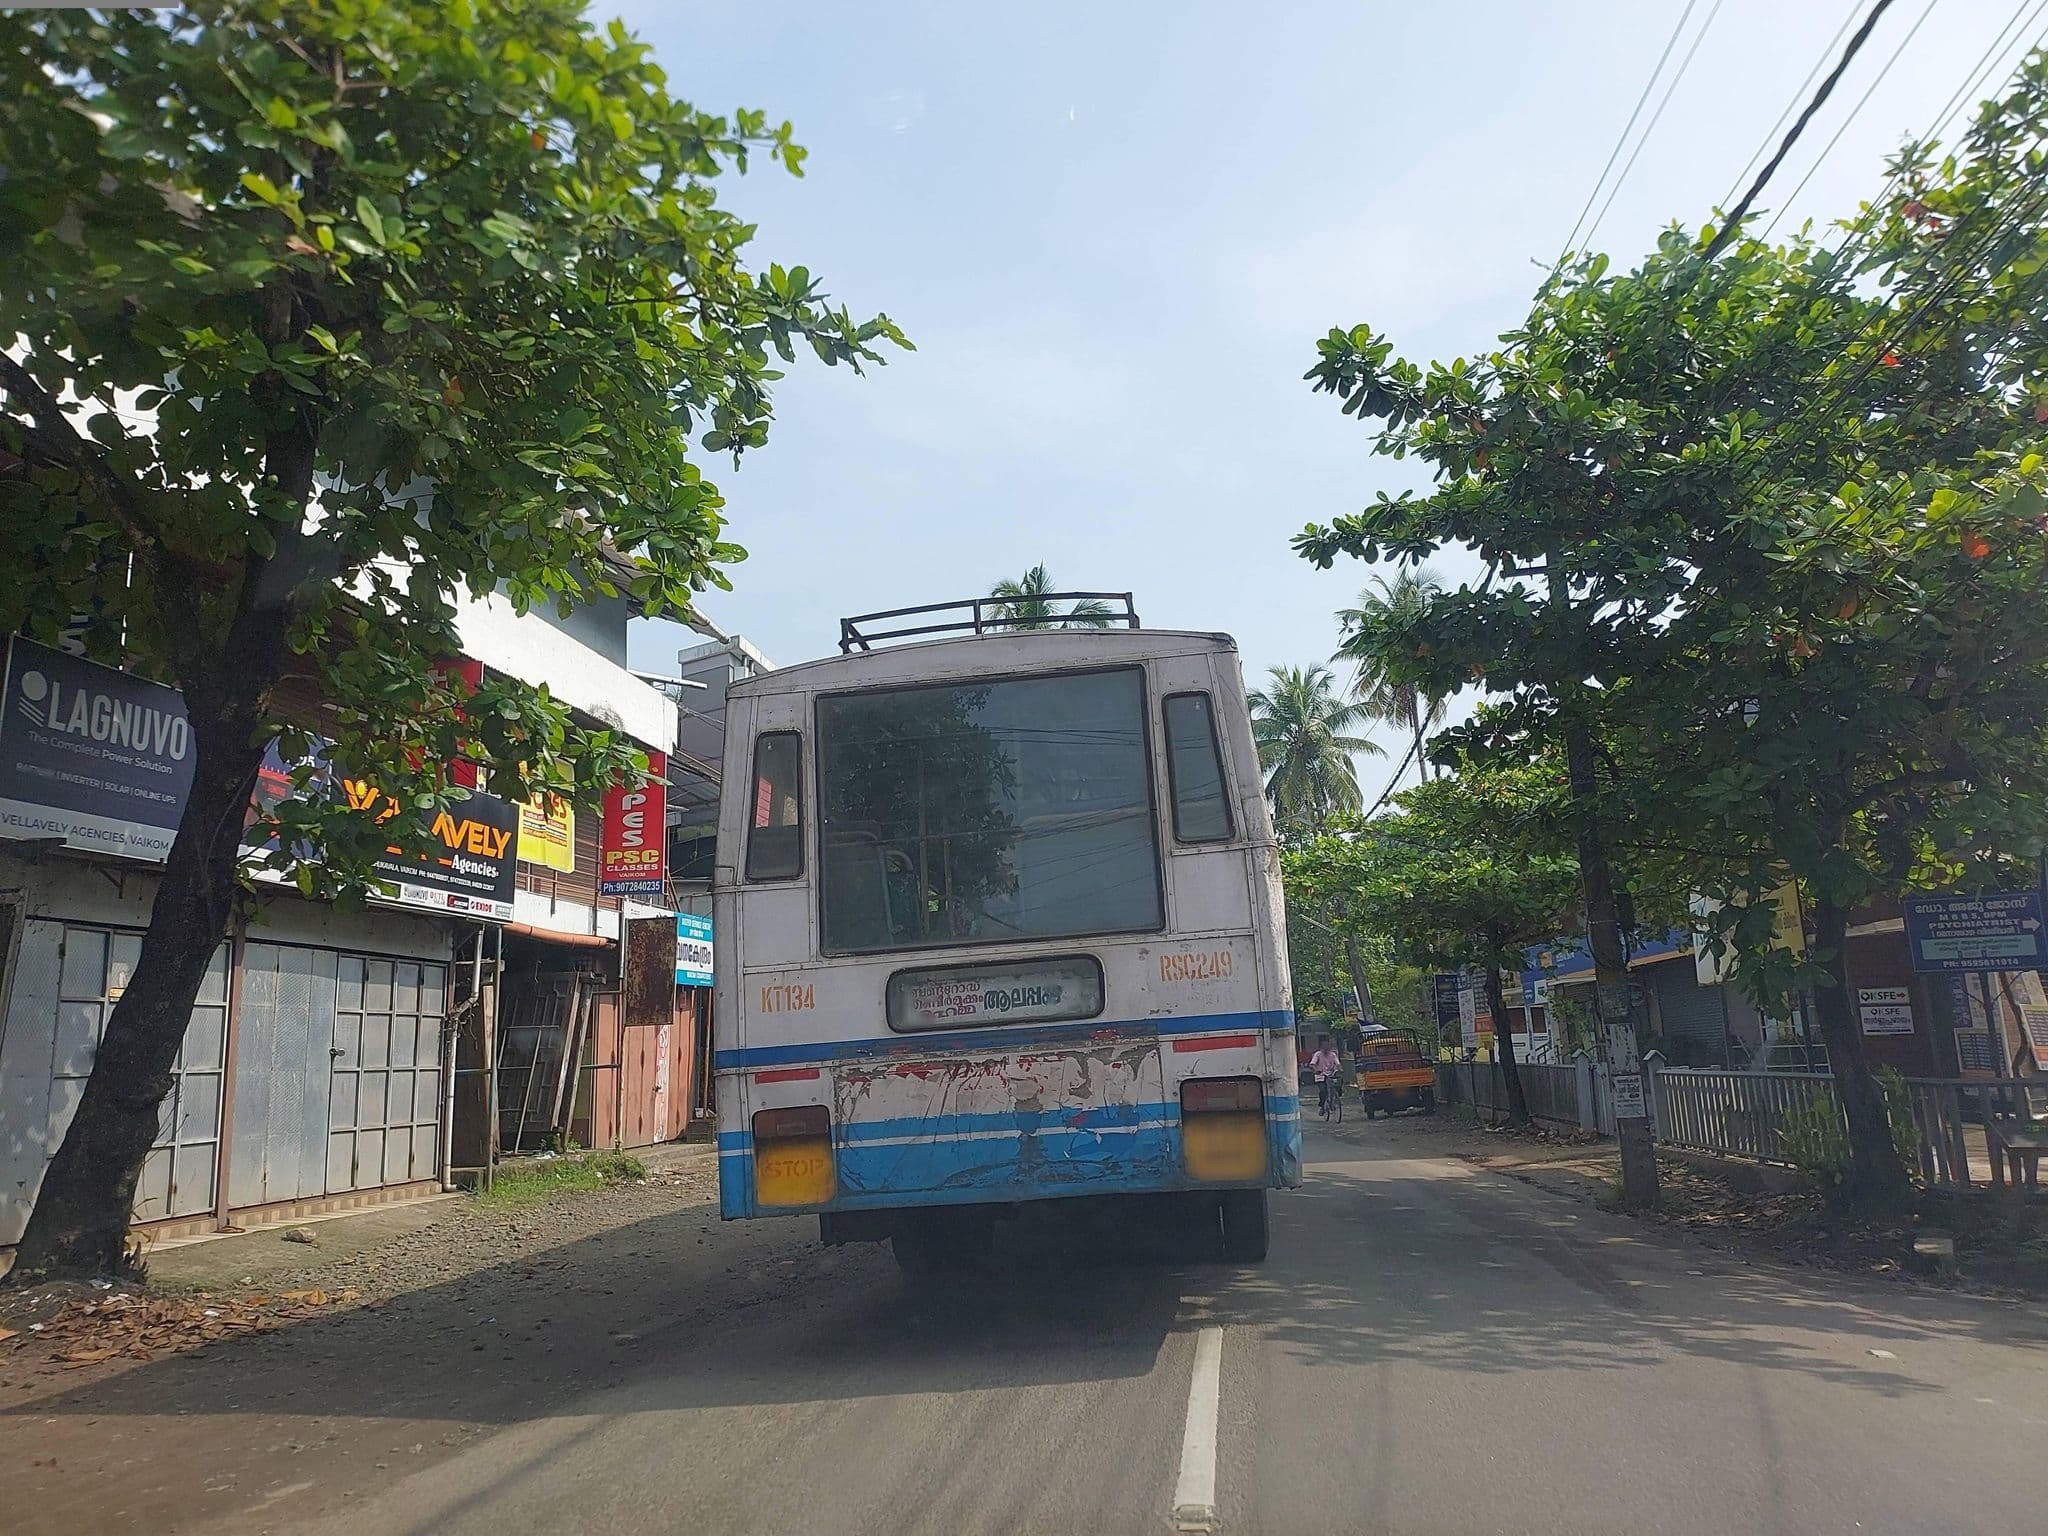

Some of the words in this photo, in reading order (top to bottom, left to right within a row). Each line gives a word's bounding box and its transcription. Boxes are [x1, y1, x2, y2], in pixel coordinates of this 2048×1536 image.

[48, 681, 188, 761] LAGNUVO
[102, 749, 134, 767] Power
[134, 757, 173, 774] Solution
[162, 793, 177, 804] UPS
[1, 812, 68, 833] VELLAVELY
[70, 825, 128, 845] AGENCIES,
[130, 834, 170, 850] VAIKOM
[606, 850, 660, 865] PSC
[451, 854, 498, 878] Agencies
[606, 863, 658, 872] CLASSES
[603, 881, 661, 893] Ph:9072840235
[475, 901, 493, 913] EXIDE
[1929, 918, 2020, 930] PSYCHIATRIST
[1159, 951, 1233, 981] RSC249
[761, 983, 815, 1013] KT134
[1871, 992, 1897, 1000] KSFE
[762, 1159, 824, 1177] STOP
